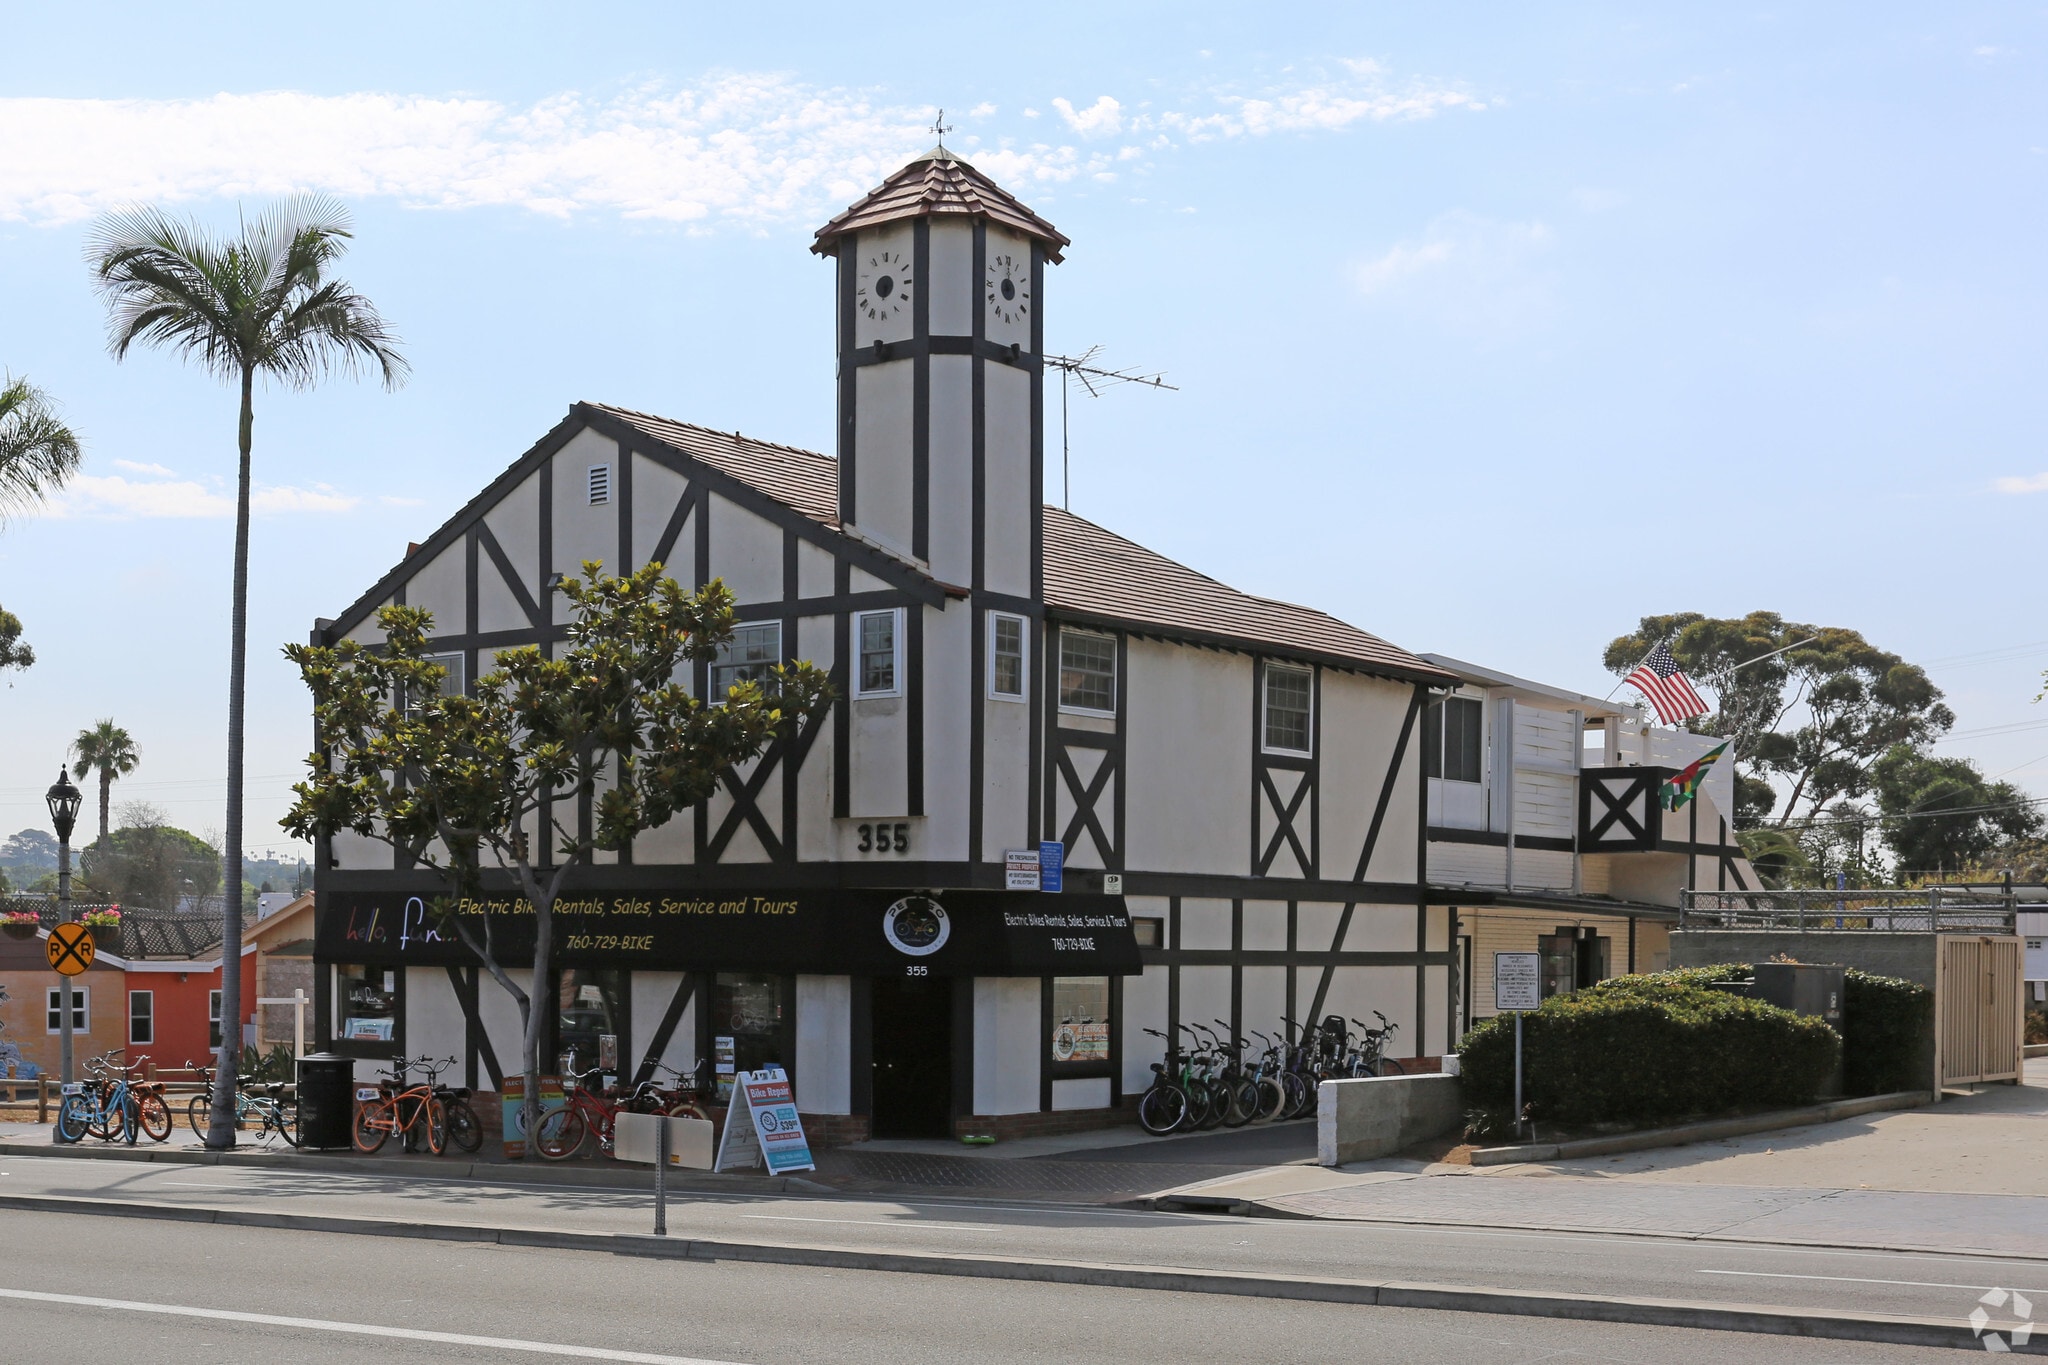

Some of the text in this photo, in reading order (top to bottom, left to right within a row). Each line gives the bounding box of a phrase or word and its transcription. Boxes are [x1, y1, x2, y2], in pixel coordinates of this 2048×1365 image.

[857, 824, 909, 853] 355
[552, 898, 606, 917] Rentals,
[611, 898, 652, 917] Sales,
[658, 897, 714, 914] Service
[718, 897, 748, 914] and
[753, 897, 798, 914] Tours
[346, 905, 387, 943] hello,
[1004, 912, 1029, 926] Electric
[1110, 915, 1127, 927] Tours
[566, 935, 654, 950] 760-729-BIKE
[906, 965, 928, 976] 355
[750, 1086, 789, 1098] Bike Repair
